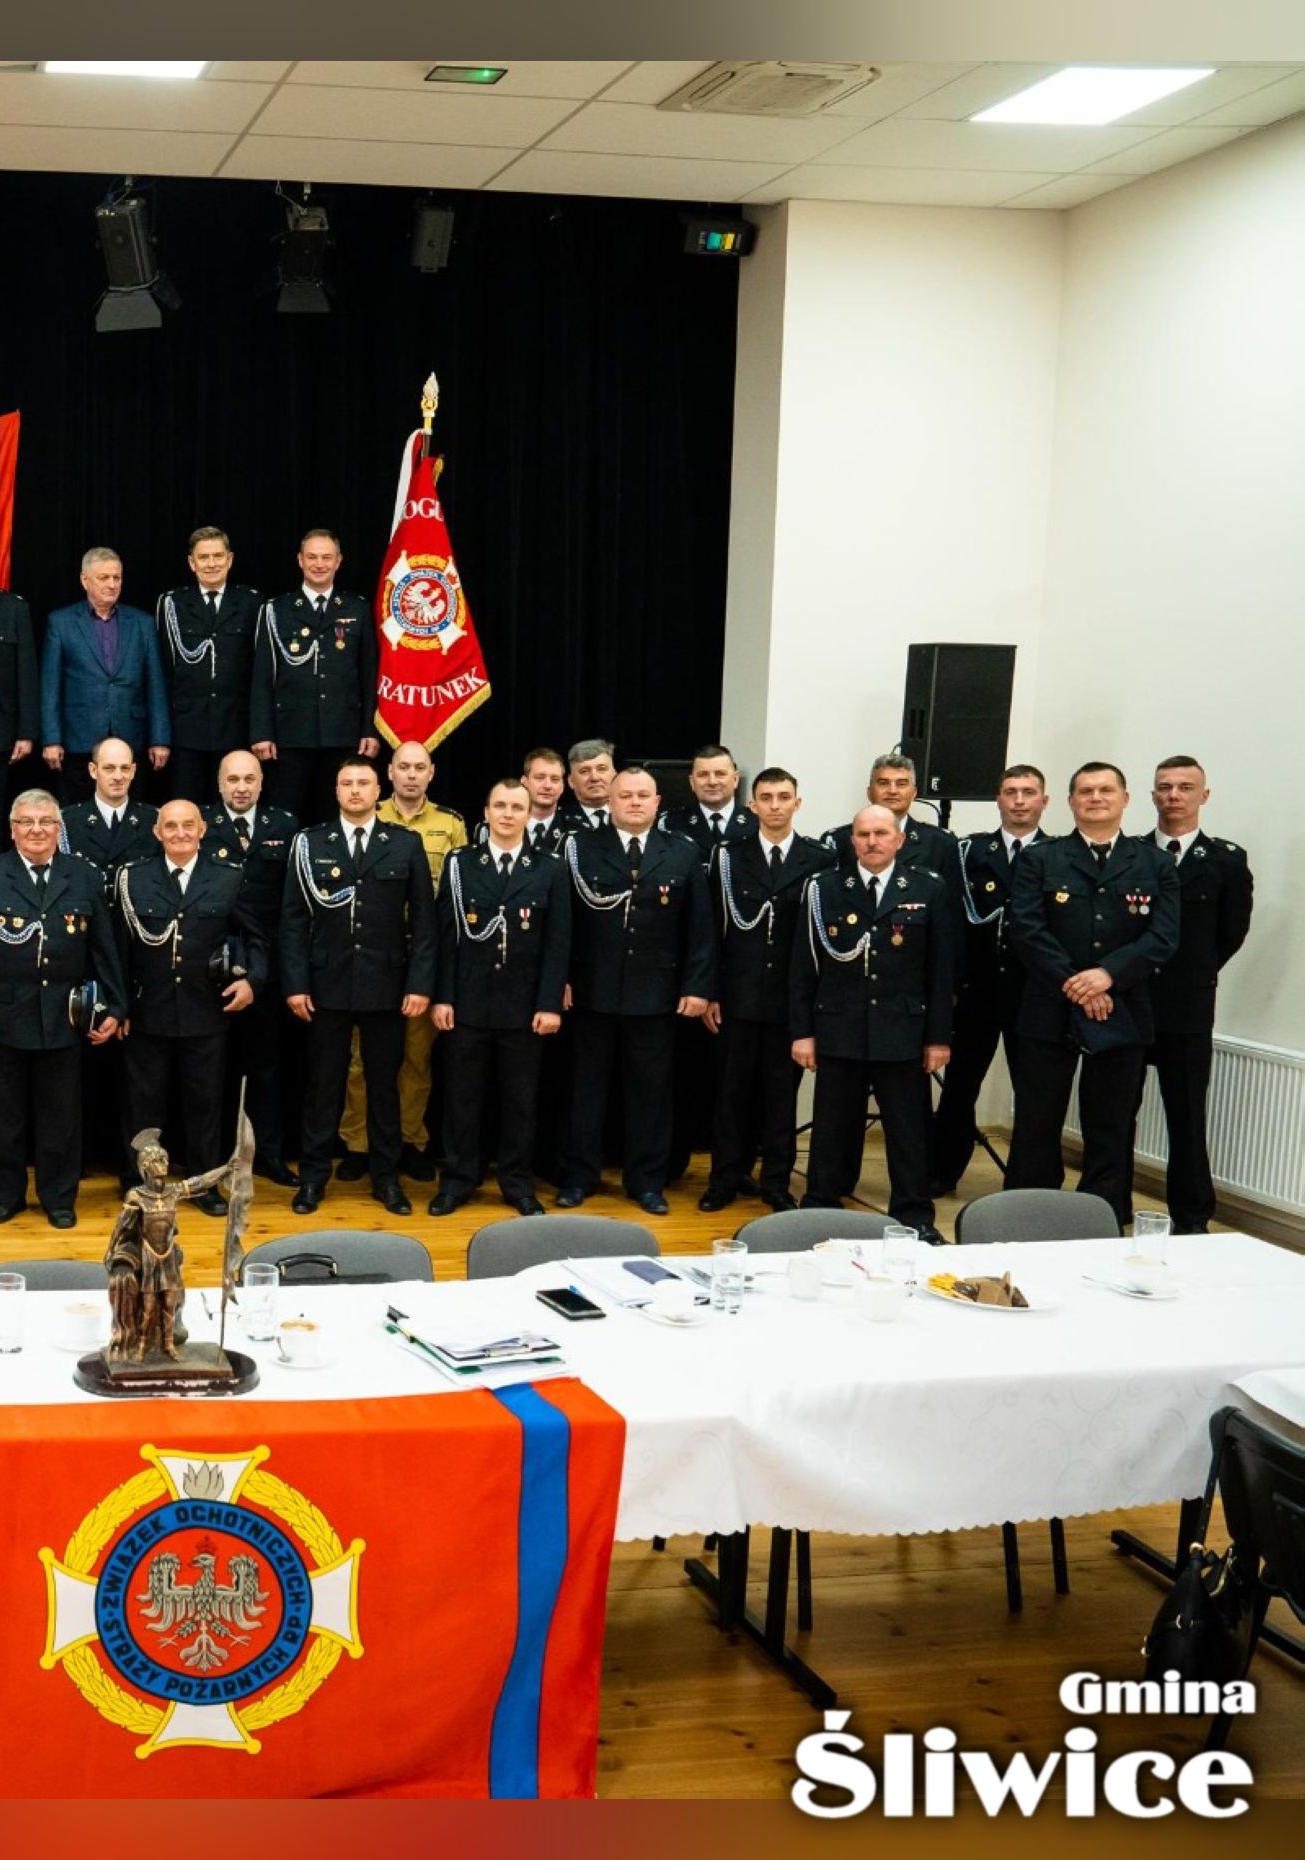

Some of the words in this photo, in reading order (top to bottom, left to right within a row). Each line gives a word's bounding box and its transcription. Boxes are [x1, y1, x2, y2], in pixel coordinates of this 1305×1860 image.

[377, 667, 488, 707] RATUNEK
[101, 1519, 167, 1609] ZWIĄZEK
[175, 1507, 307, 1605] OCHOTNICZYCH
[101, 1617, 160, 1686] STRAŻY
[164, 1646, 290, 1701] POŻARNYCH
[284, 1618, 304, 1647] RP
